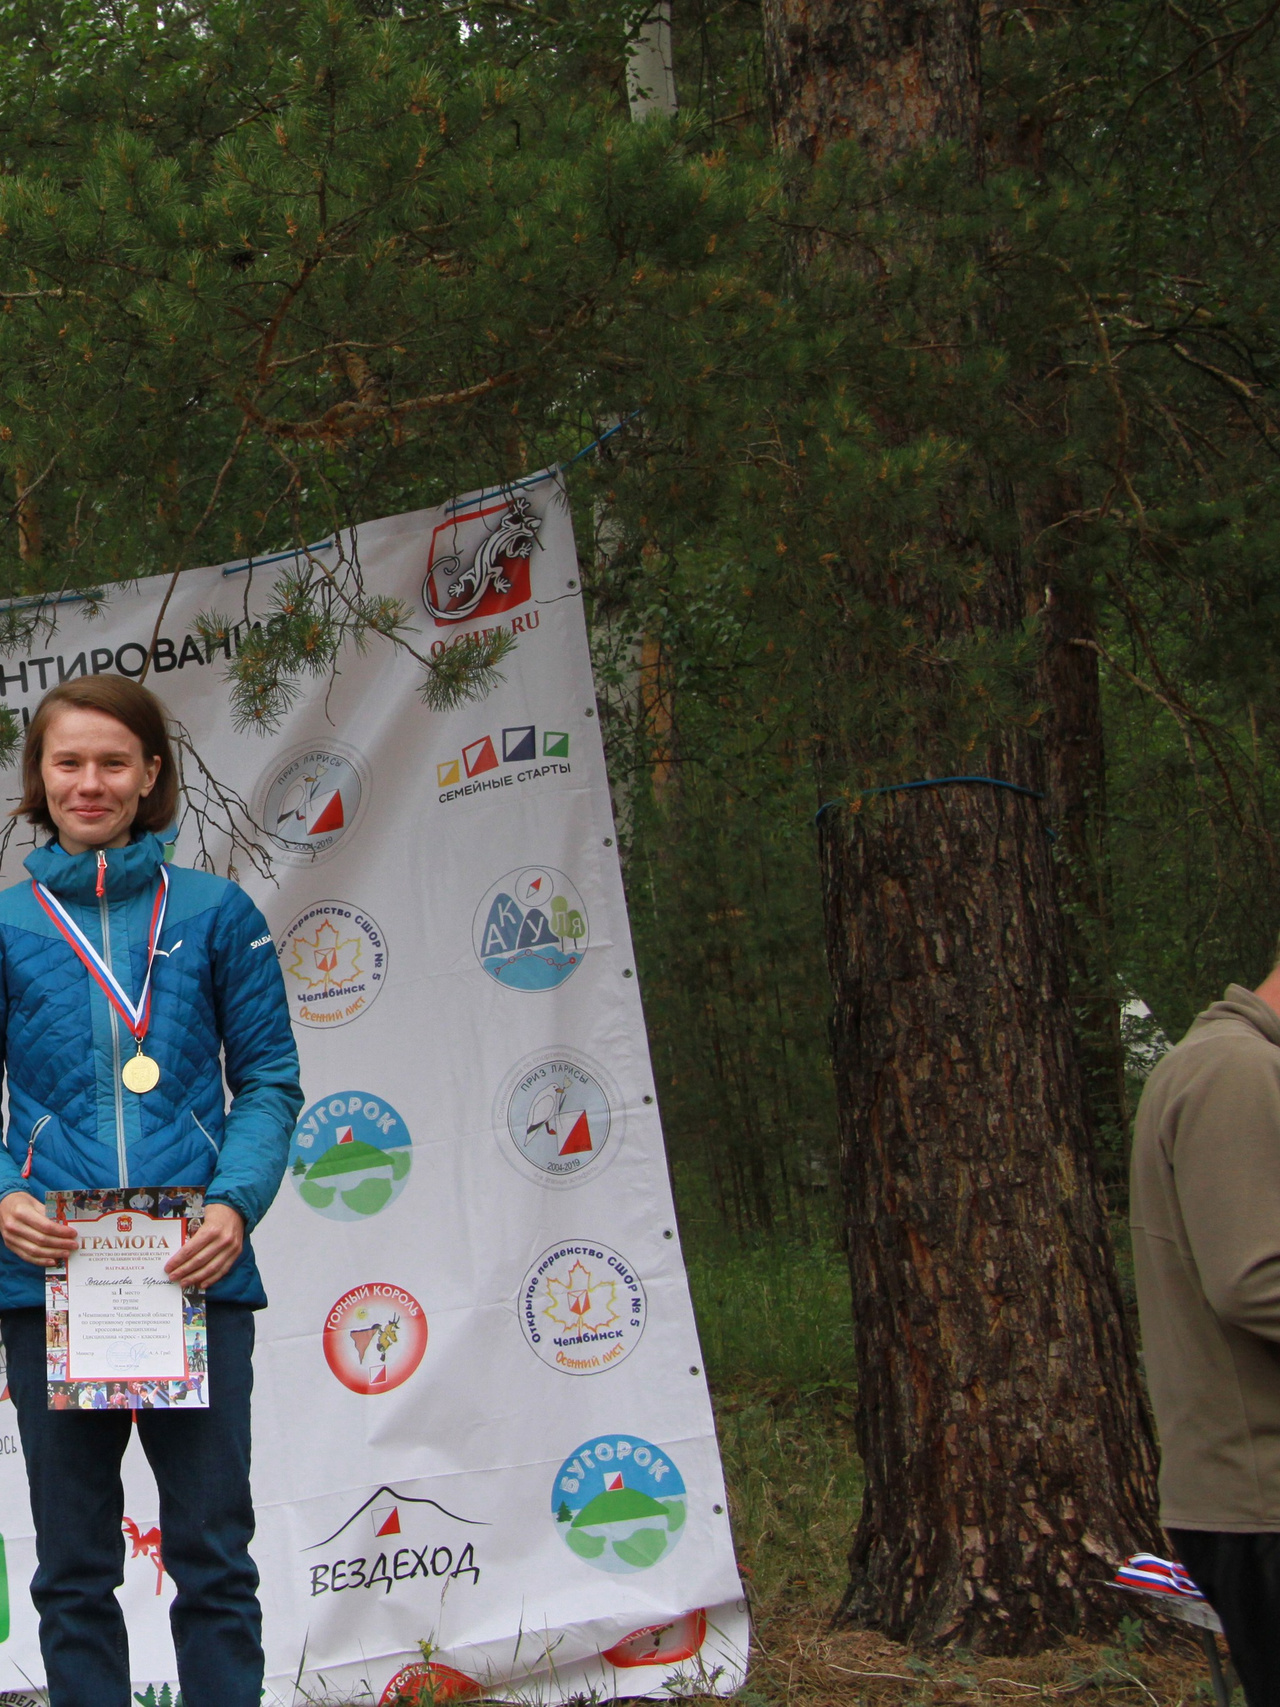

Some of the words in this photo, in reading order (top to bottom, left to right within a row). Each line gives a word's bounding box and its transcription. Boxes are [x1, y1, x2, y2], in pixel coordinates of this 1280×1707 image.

[277, 763, 300, 785] ПРИЗ
[303, 754, 342, 767] ЛАРИСЫ
[438, 775, 513, 804] СЕМЕЙНЫЕ
[517, 762, 571, 783] СТАРТЫ
[287, 907, 352, 938] первенство
[354, 915, 382, 949] СШОР
[372, 973, 381, 981] 5
[297, 984, 366, 1003] Челябинск
[299, 1006, 343, 1022] Осенний
[520, 1069, 547, 1092] ПРИЗ
[551, 1064, 589, 1085] ЛАРИСЫ
[296, 1096, 397, 1149] БУГОРОК
[547, 1158, 581, 1171] 2004-2019
[80, 1235, 169, 1250] ГРАМОТА
[537, 1247, 604, 1275] первенство
[607, 1256, 638, 1292] СШОР
[327, 1285, 370, 1330] ГОРНЫЙ
[373, 1285, 419, 1317] КОРОЛЬ
[525, 1276, 541, 1343] Открытое
[631, 1298, 641, 1314] №
[630, 1318, 640, 1327] 5
[553, 1329, 624, 1347] Челябинск
[555, 1350, 600, 1369] Осенний
[560, 1440, 670, 1494] БУГОРОК
[309, 1542, 480, 1597] ВЕЗДЕХОД
